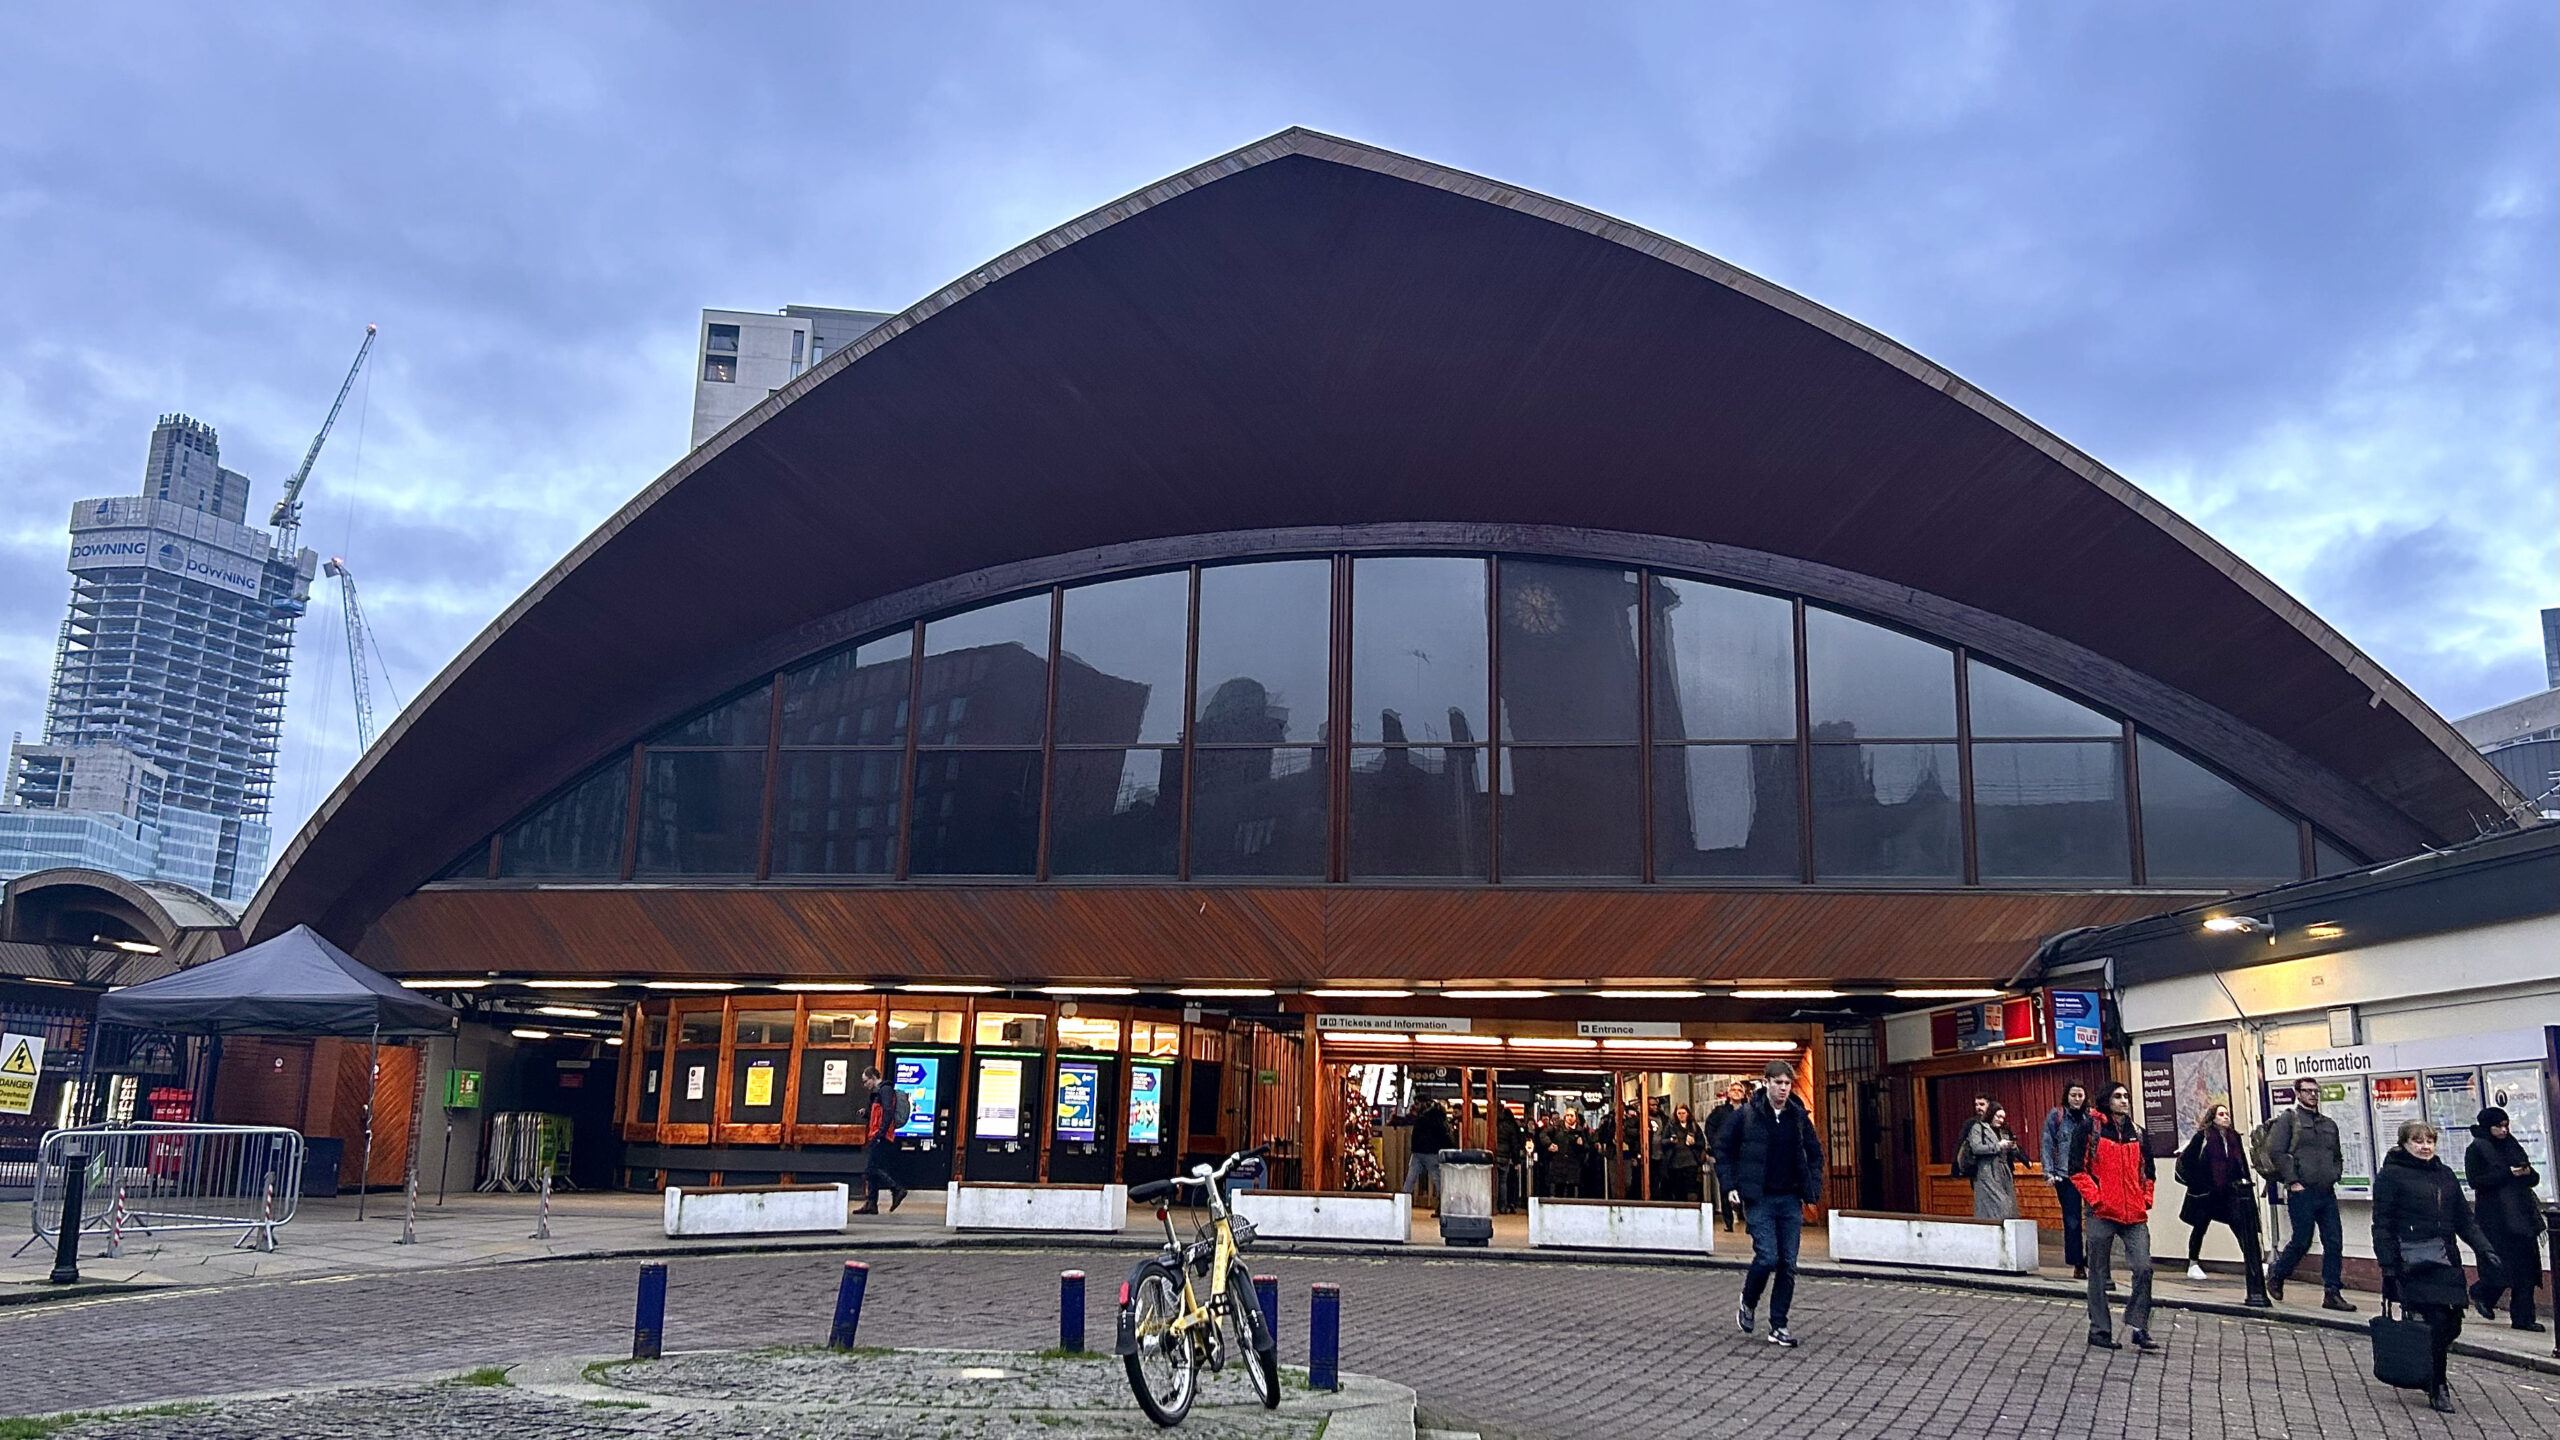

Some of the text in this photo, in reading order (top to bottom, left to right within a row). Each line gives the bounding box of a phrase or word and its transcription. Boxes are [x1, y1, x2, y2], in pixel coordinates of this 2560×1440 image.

[72, 542, 146, 558] DOWNING
[187, 559, 256, 590] DOWNING
[1340, 1018, 1447, 1029] Tickets and Information
[1591, 1024, 1634, 1034] Entrance
[2076, 1033, 2097, 1042] TO LET
[2294, 1053, 2371, 1074] Information
[2143, 1069, 2163, 1077] Welcome
[0, 1078, 34, 1090] DANGER
[2144, 1079, 2170, 1088] Manchester
[0, 1089, 30, 1099] Overhead
[2145, 1089, 2172, 1098] Oxford Road
[2509, 1092, 2537, 1101] NORTHERN
[2146, 1100, 2162, 1108] Station
